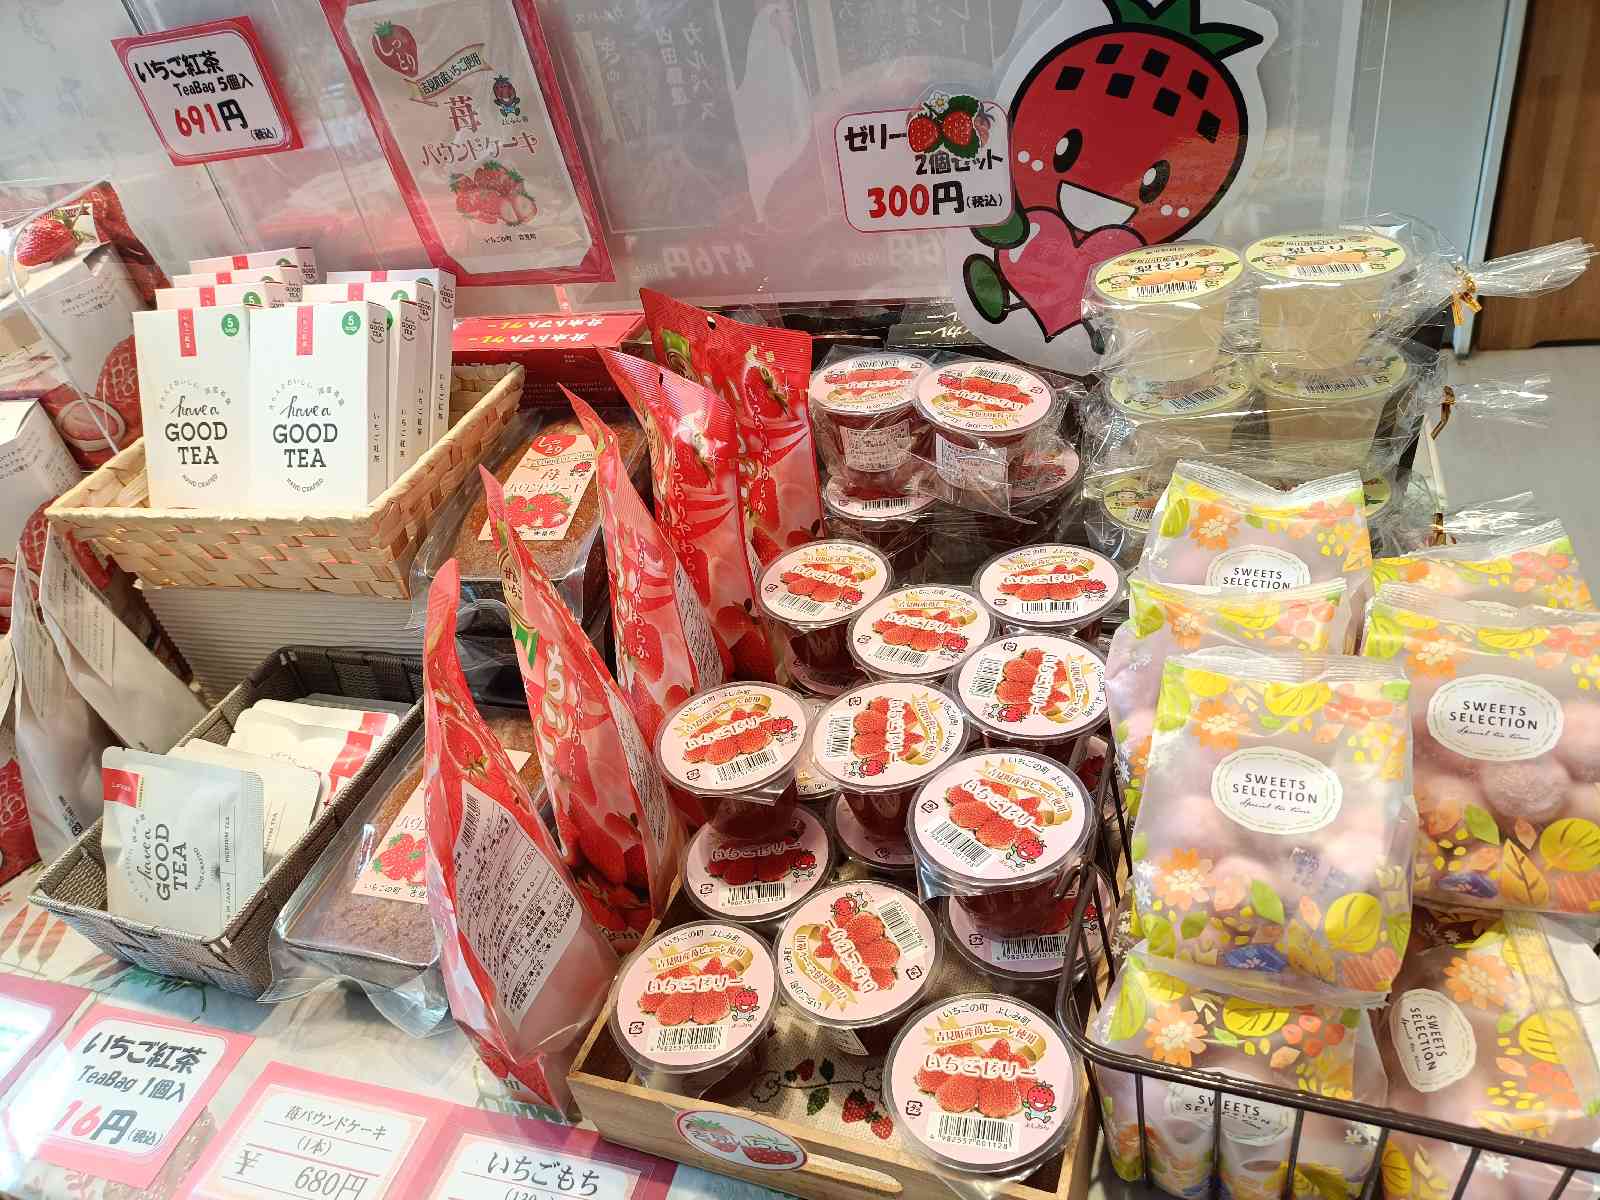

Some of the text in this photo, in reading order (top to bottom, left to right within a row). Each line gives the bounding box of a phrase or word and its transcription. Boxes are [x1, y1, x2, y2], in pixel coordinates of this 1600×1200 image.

[373, 34, 416, 71] しっとり
[135, 50, 224, 83] いちご紅茶
[173, 73, 254, 97] TeaBag 5個入
[174, 99, 248, 137] 691円
[448, 96, 481, 132] 苺
[250, 127, 278, 141] (税込)
[844, 124, 908, 152] ゼリー
[422, 132, 538, 166] パウンドケーキ
[868, 180, 965, 218] 300円
[967, 193, 1003, 209] (税込)
[227, 317, 234, 327] 5
[347, 315, 354, 325] 5
[170, 396, 207, 417] have
[209, 406, 220, 416] a
[280, 395, 320, 418] have
[321, 406, 331, 416] a
[165, 422, 228, 441] GOOD
[273, 423, 338, 443] GOOD
[177, 447, 219, 464] TEA
[284, 449, 327, 467] TEA
[1223, 577, 1291, 590] SELECTION
[1233, 567, 1284, 579] SWEETS
[1463, 700, 1526, 716] SWEETS
[1449, 711, 1538, 730] SELECTION
[1232, 784, 1318, 804] SELECTION
[1244, 774, 1306, 790] SWEETS
[155, 823, 171, 900] GOOD
[172, 842, 188, 890] TEA
[943, 1003, 1033, 1027] いちごの町 よしみ町
[1409, 1007, 1436, 1072] SELECTION
[1424, 1015, 1448, 1057] SWEETS
[83, 1031, 207, 1074] いちご紅茶
[77, 1064, 187, 1102] TeaBag 1個入
[53, 1100, 138, 1144] 16円
[285, 1105, 388, 1141] 苺パウンドケーキ
[127, 1129, 164, 1146] (税込)
[297, 1135, 333, 1156] (1本)
[234, 1149, 369, 1200] ¥ 680円
[487, 1151, 601, 1196] いちごもち
